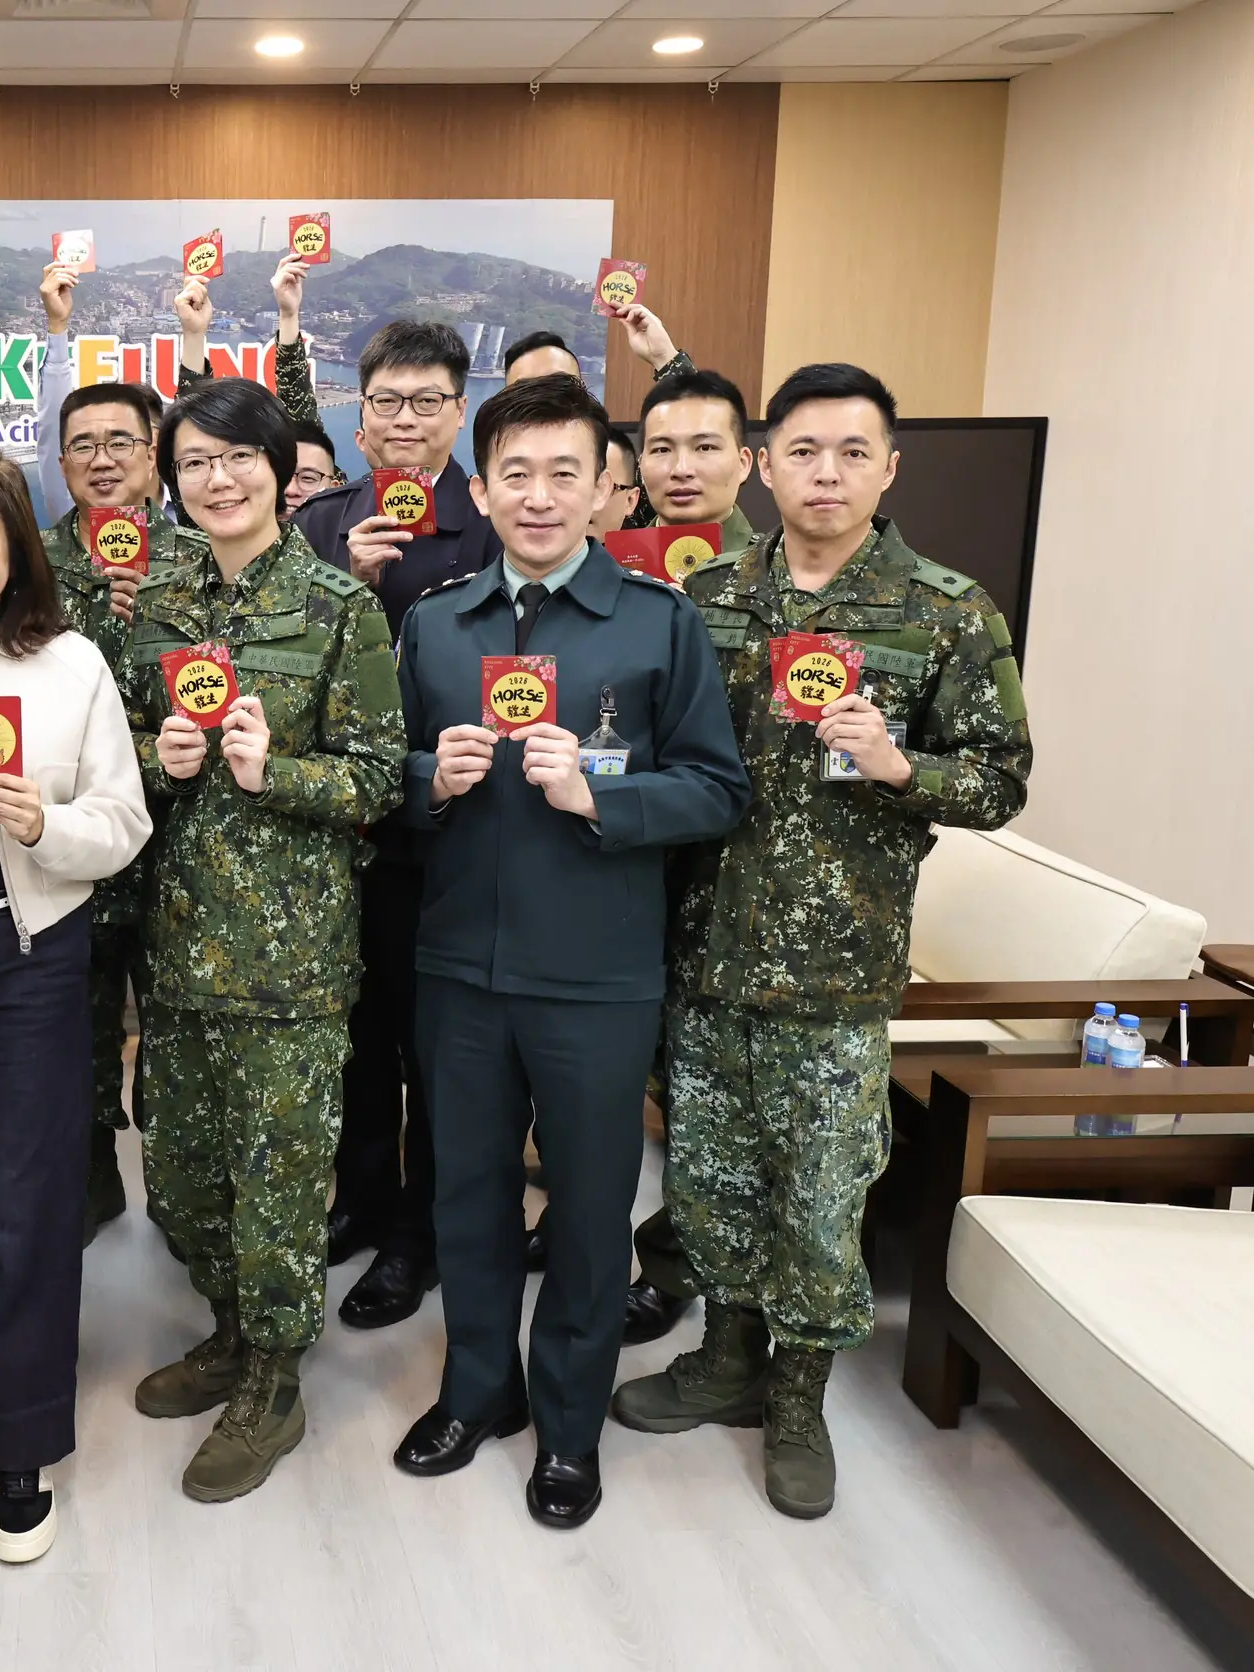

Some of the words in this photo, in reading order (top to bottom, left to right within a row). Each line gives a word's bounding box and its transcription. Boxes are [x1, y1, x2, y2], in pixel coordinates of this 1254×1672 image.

[295, 233, 323, 244] HORSE
[603, 283, 635, 295] HORSE
[9, 418, 38, 443] cit
[384, 494, 424, 509] HORSE
[99, 533, 138, 547] HORSE
[812, 657, 832, 667] 2026
[187, 665, 205, 675] 2026
[509, 677, 528, 685] 2026
[790, 669, 844, 689] HORSE
[178, 675, 224, 698] HORSE
[493, 688, 544, 703] HORSE
